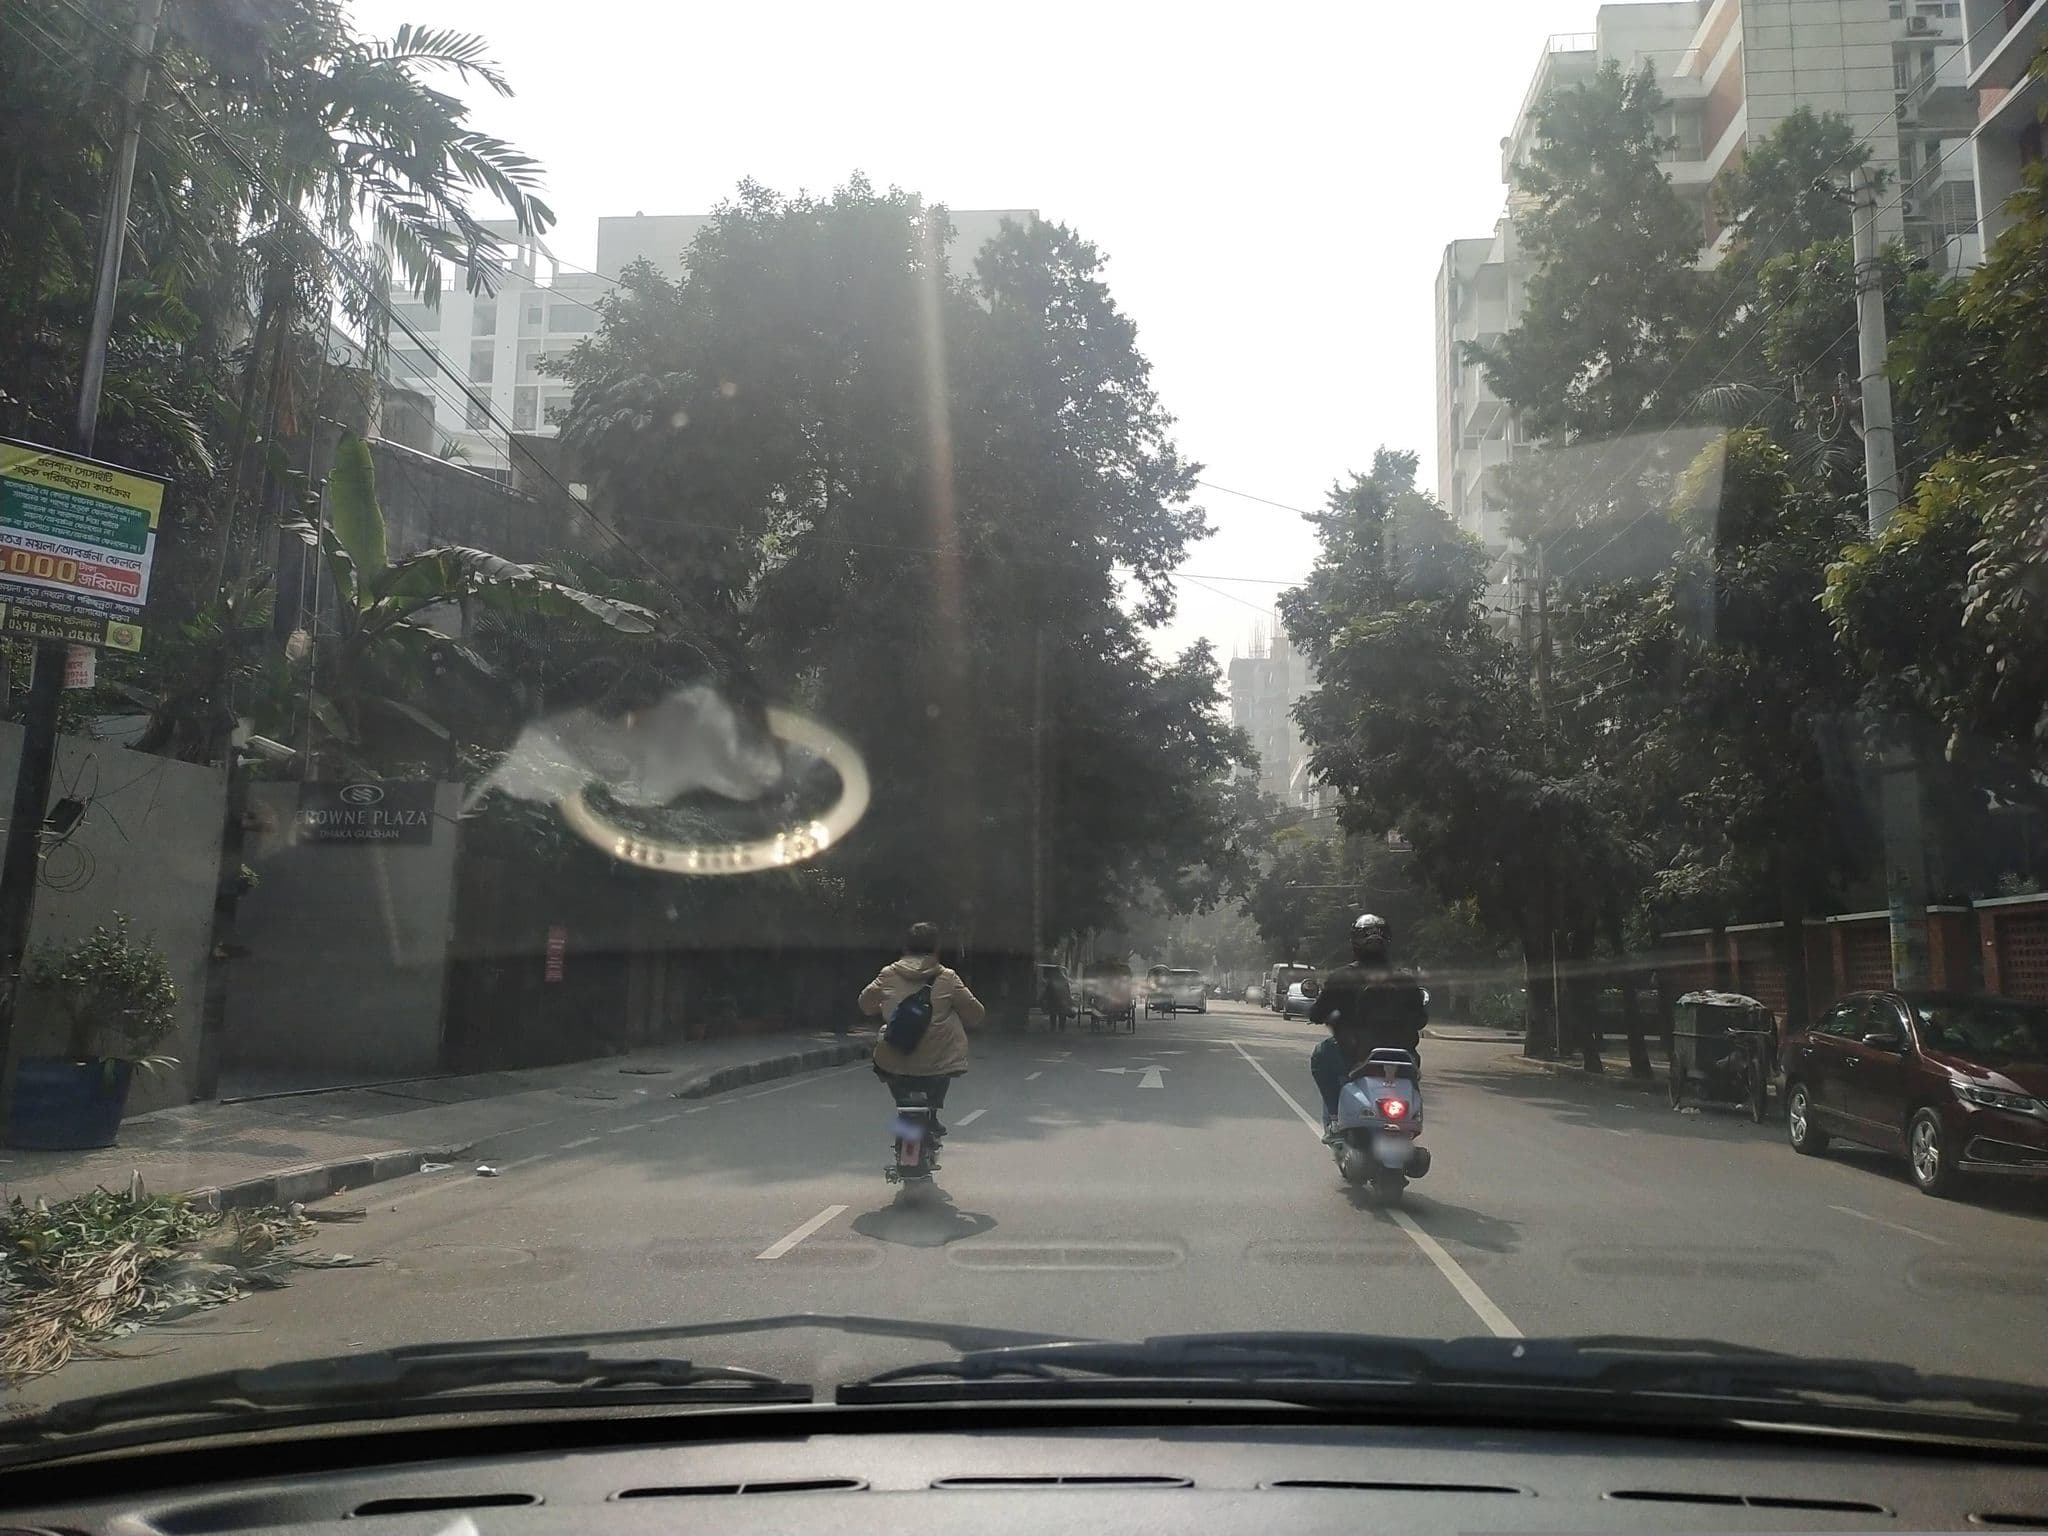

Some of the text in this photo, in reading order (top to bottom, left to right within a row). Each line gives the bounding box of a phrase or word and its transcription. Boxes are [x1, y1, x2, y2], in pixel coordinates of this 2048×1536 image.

[75, 466, 114, 482] সোসাইটি
[93, 481, 132, 499] কার্যক্রম
[25, 537, 104, 563] ময়লা/আবর্জনা
[106, 554, 142, 571] ফেললে
[78, 572, 138, 596] জরিমানা
[295, 810, 428, 825] CROWNE PLAZA
[319, 829, 400, 839] DHAKA GULSHAN
